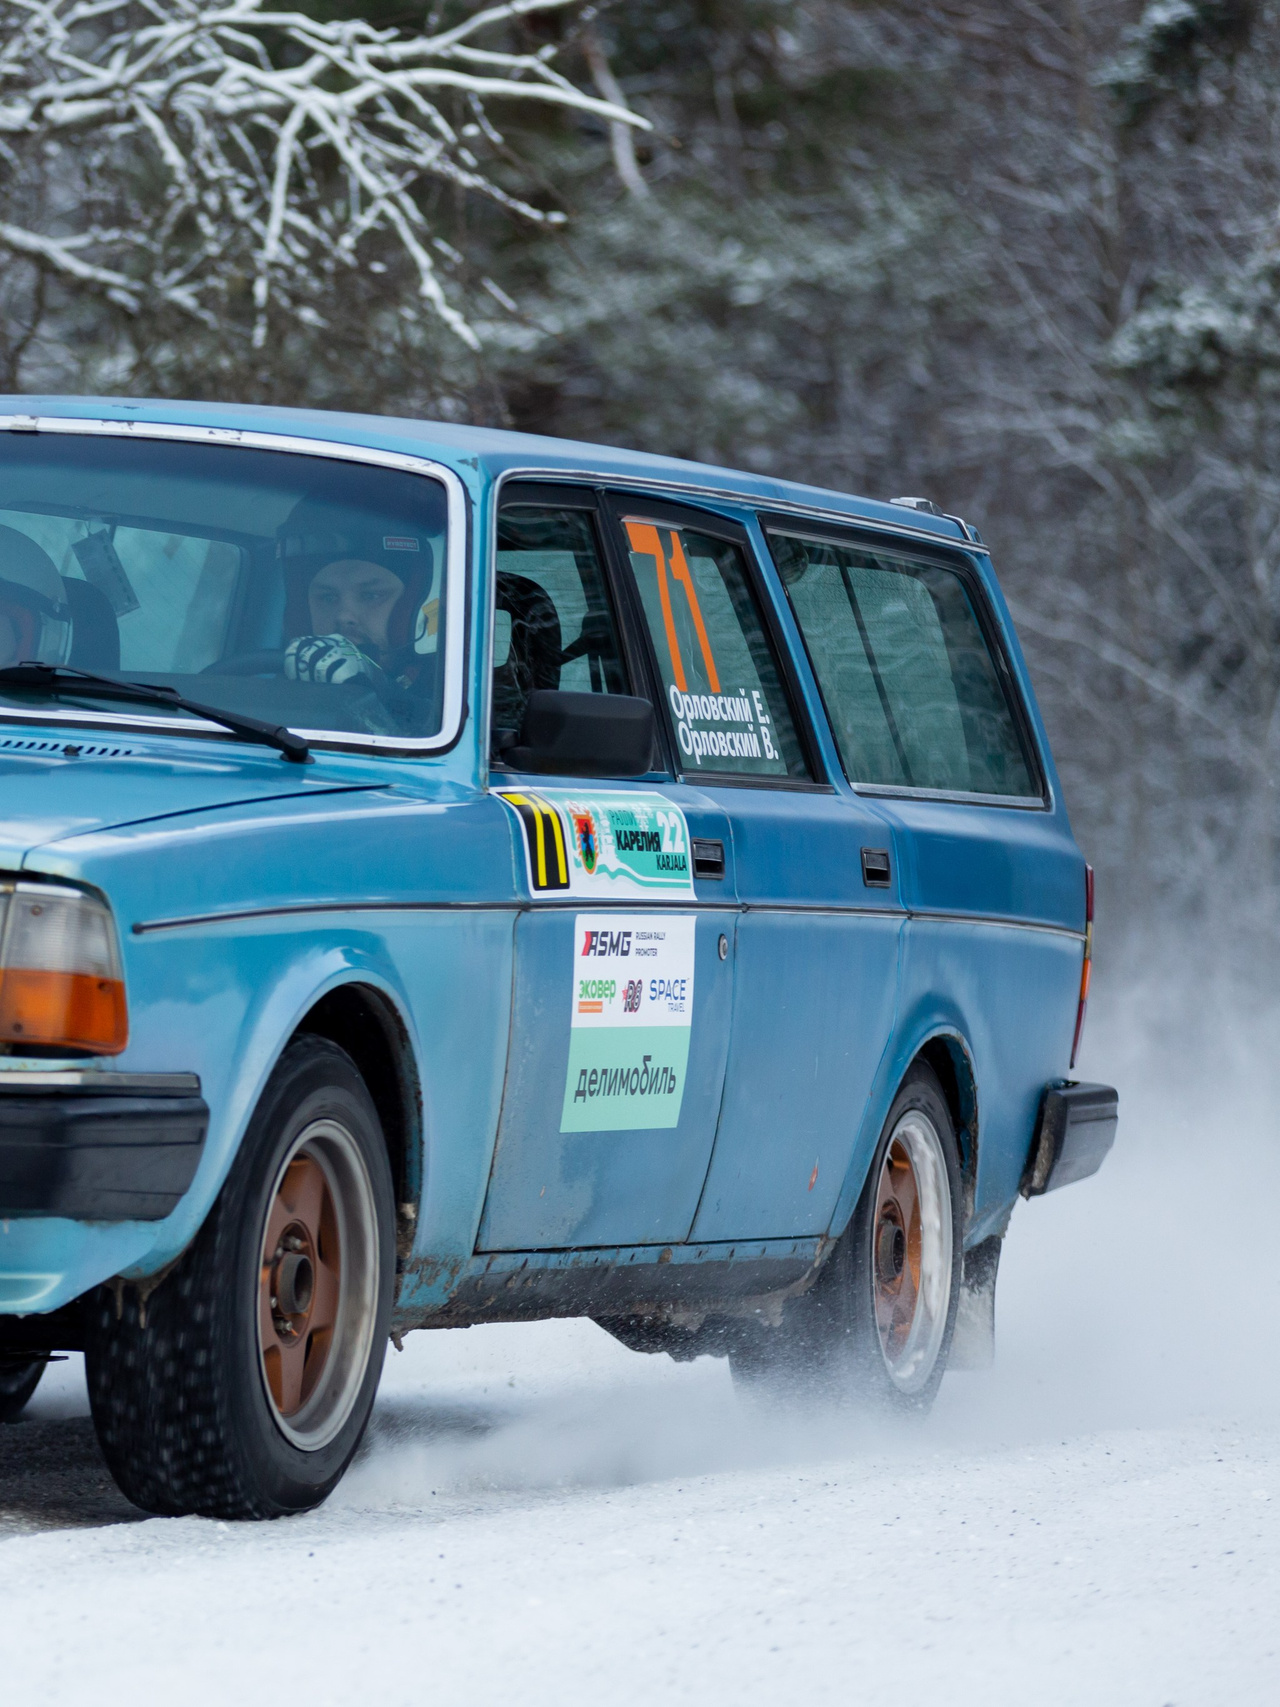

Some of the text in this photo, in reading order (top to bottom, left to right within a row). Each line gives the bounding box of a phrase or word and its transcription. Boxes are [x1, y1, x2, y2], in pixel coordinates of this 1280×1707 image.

[625, 522, 721, 694] 71
[670, 685, 770, 728] Орловский Е.
[678, 721, 779, 765] Орловский В.
[502, 793, 568, 887] 71
[615, 830, 662, 852] КАРЕЛИЯ
[656, 811, 686, 853] 22
[656, 854, 687, 871] KARJALA
[649, 979, 686, 1001] SPACE
[574, 1055, 677, 1103] делимобиль
